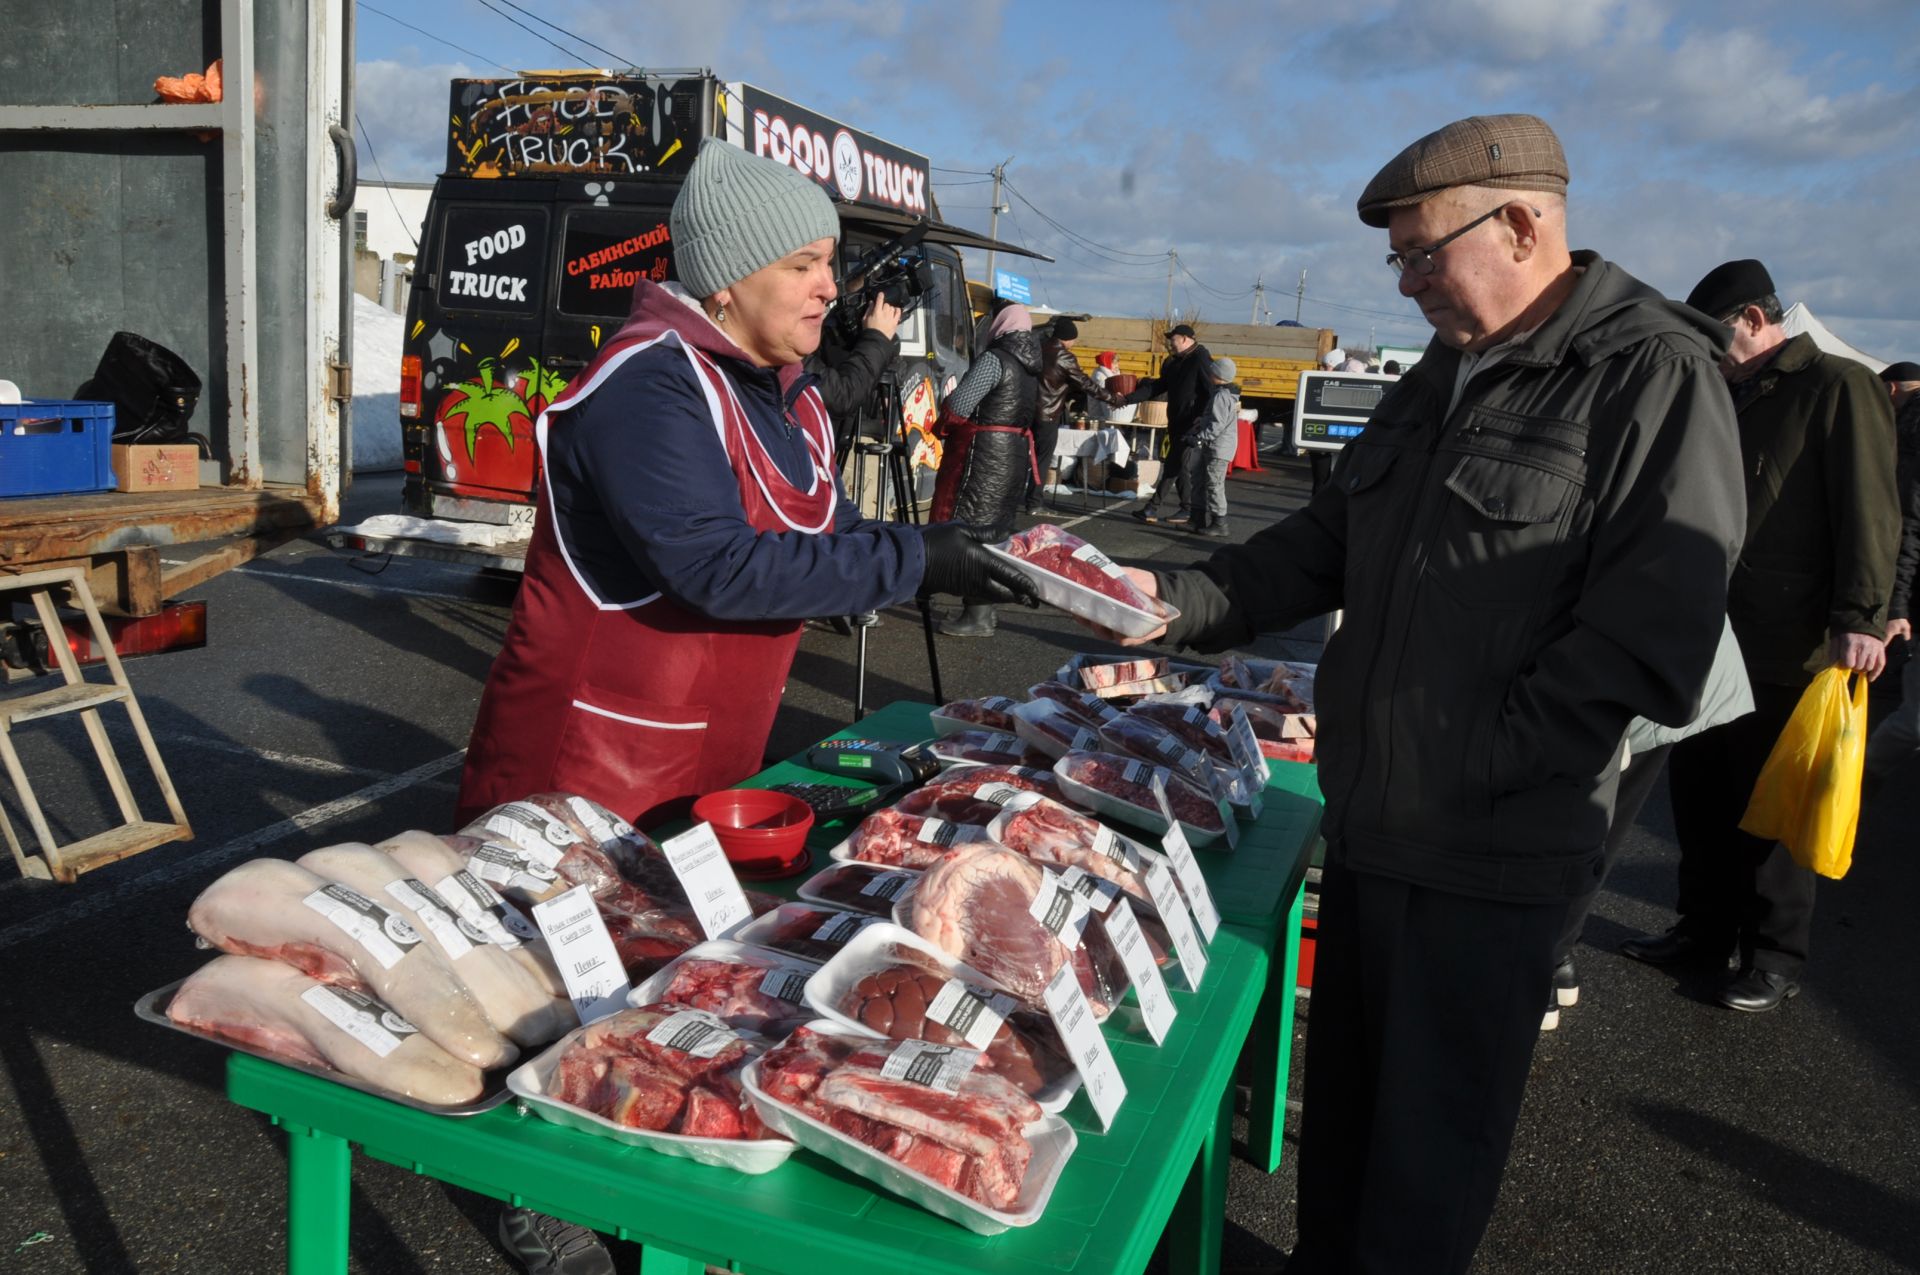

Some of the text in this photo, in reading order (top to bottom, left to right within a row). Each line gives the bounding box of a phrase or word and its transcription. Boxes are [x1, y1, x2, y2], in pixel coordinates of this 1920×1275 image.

[754, 110, 926, 211] FOOD TRUCK
[465, 225, 526, 266] FOOD
[567, 223, 671, 276] САБИНСКИЙ
[450, 270, 528, 301] TRUCK
[574, 956, 600, 975] Цена:
